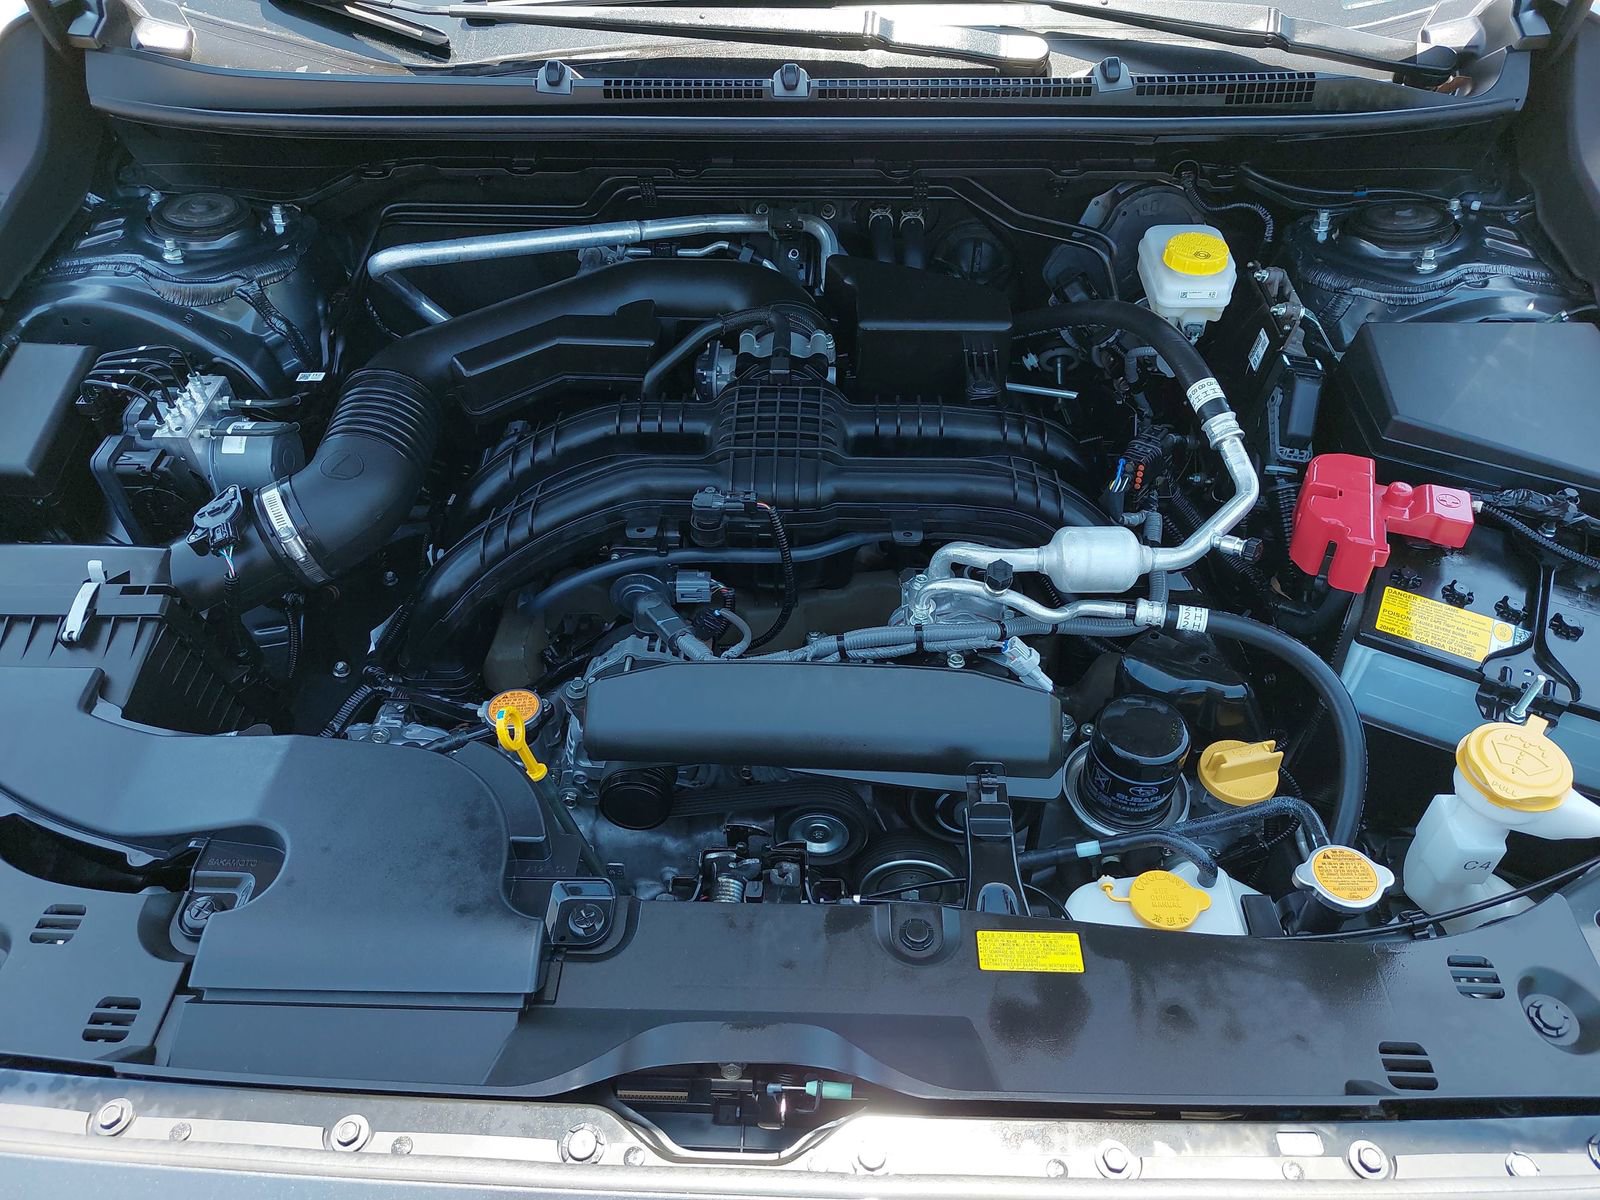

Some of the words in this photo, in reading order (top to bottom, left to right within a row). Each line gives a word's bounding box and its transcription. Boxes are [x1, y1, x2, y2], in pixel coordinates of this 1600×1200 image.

[1387, 588, 1417, 601] DANGER
[1382, 608, 1411, 621] POISON
[1415, 619, 1433, 627] CAUSES
[1379, 624, 1395, 632] 20HR
[1414, 635, 1428, 643] CCA
[1429, 640, 1446, 648] 620A
[1491, 781, 1517, 797] PULL
[207, 858, 258, 868] SAKAMOTO
[1463, 860, 1492, 871] C4
